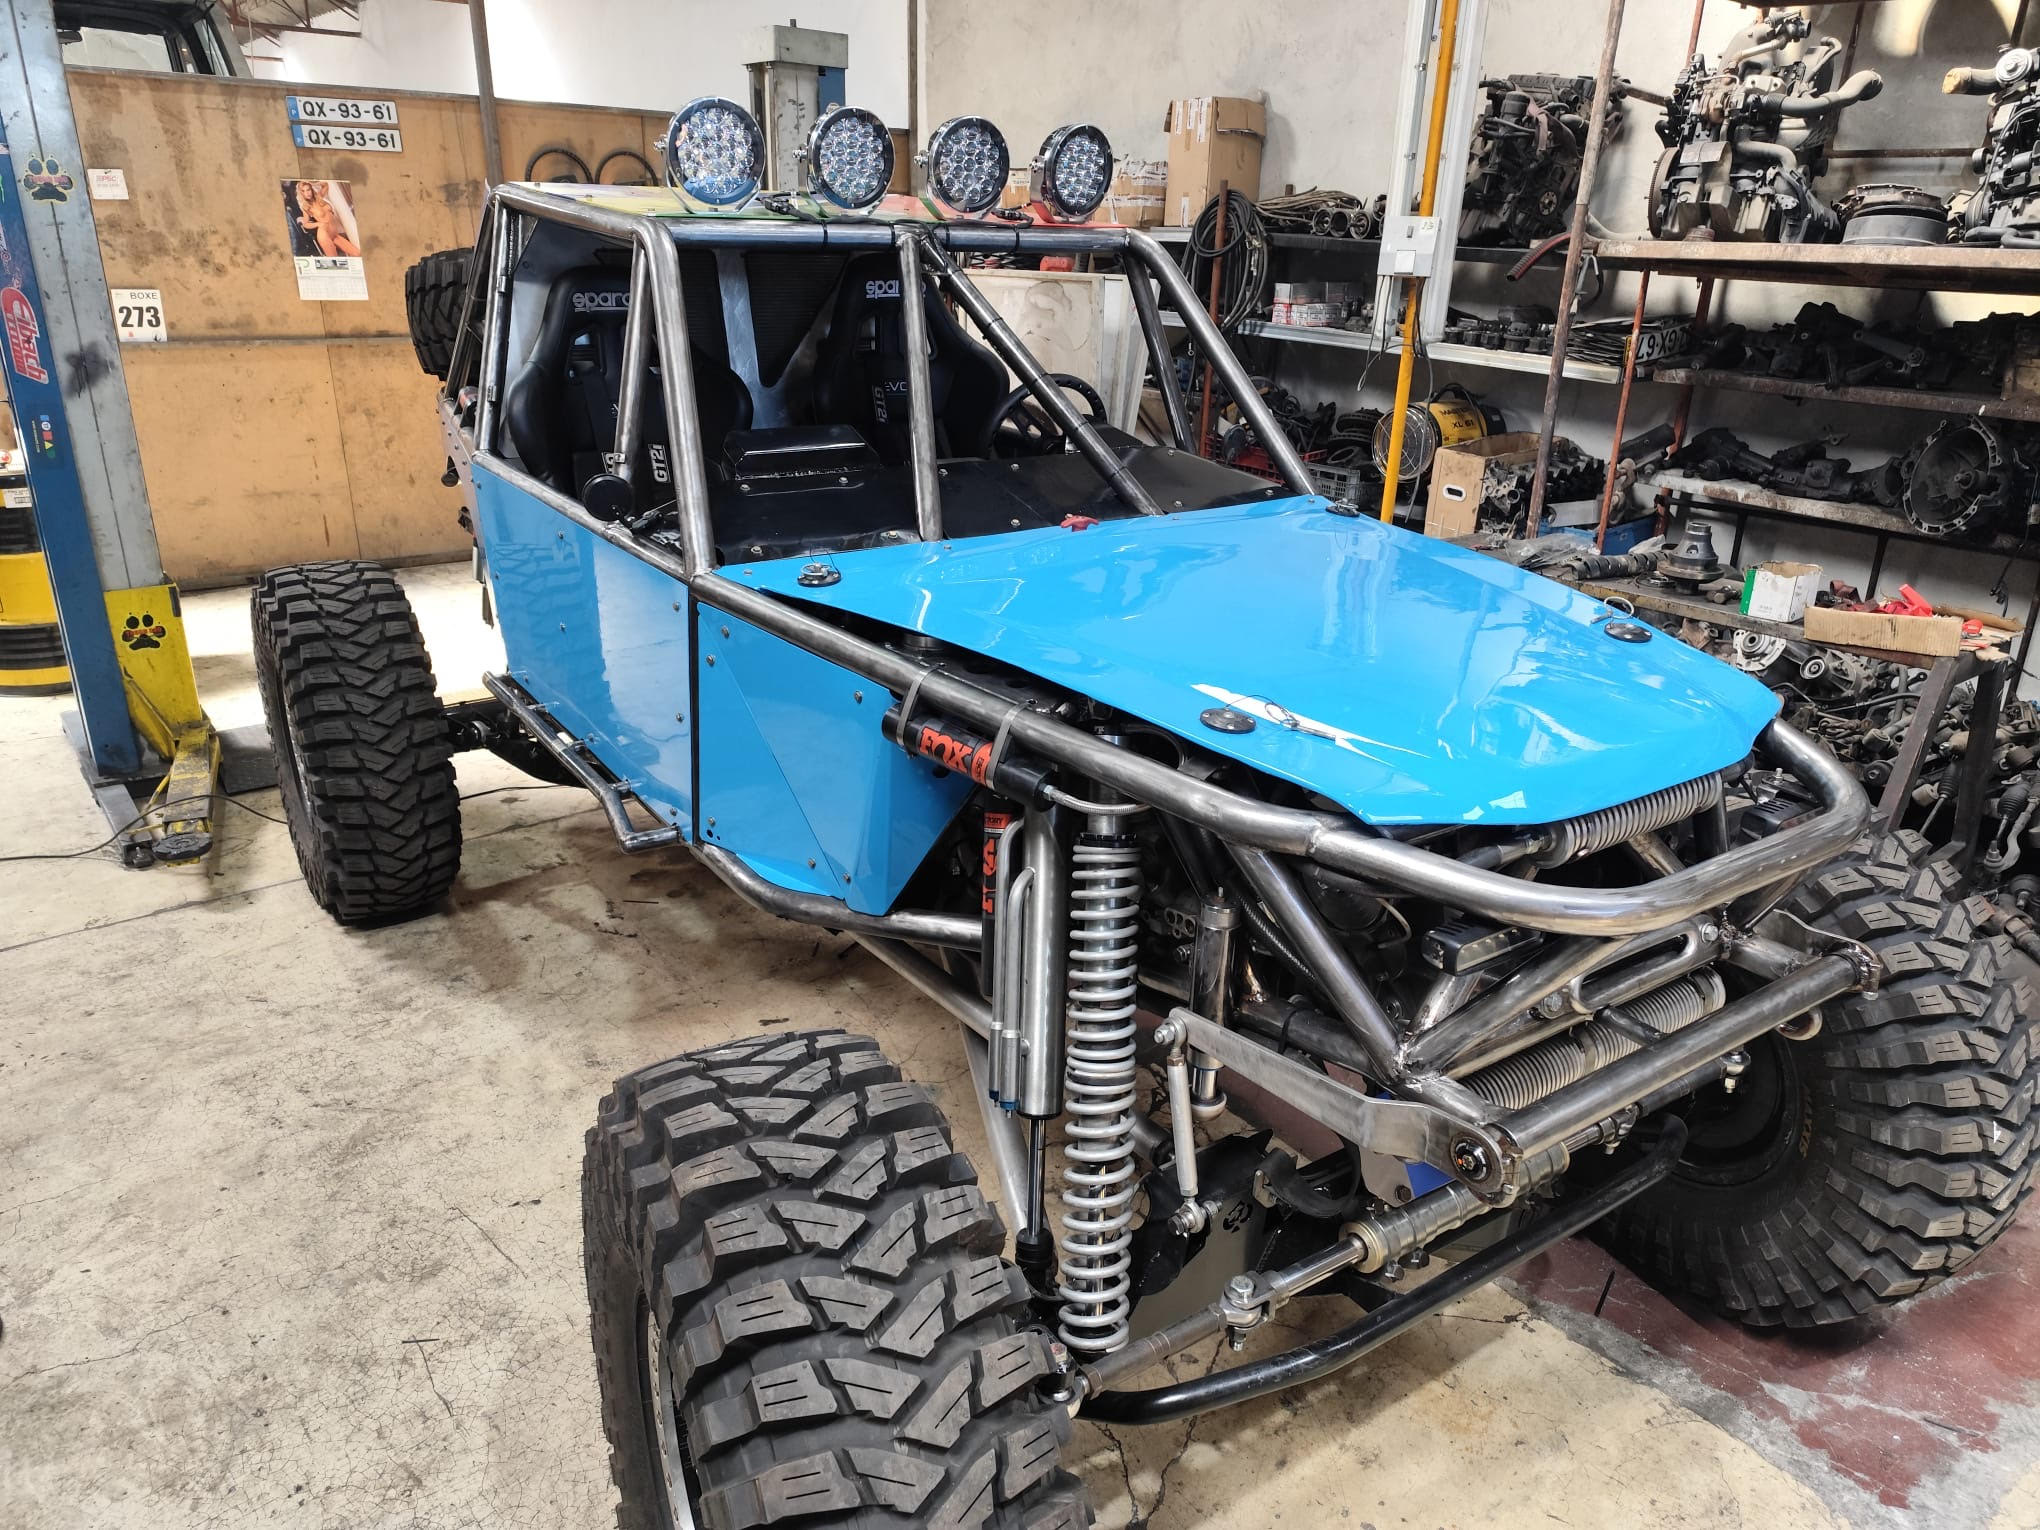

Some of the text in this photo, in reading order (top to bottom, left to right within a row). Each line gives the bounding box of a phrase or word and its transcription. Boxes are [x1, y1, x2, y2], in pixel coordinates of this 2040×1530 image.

[302, 101, 392, 121] QX-93-61
[308, 129, 396, 149] QX-93-61
[130, 292, 158, 300] BOXE
[572, 292, 631, 312] sparc
[118, 306, 161, 328] 273
[920, 726, 973, 774] FOX
